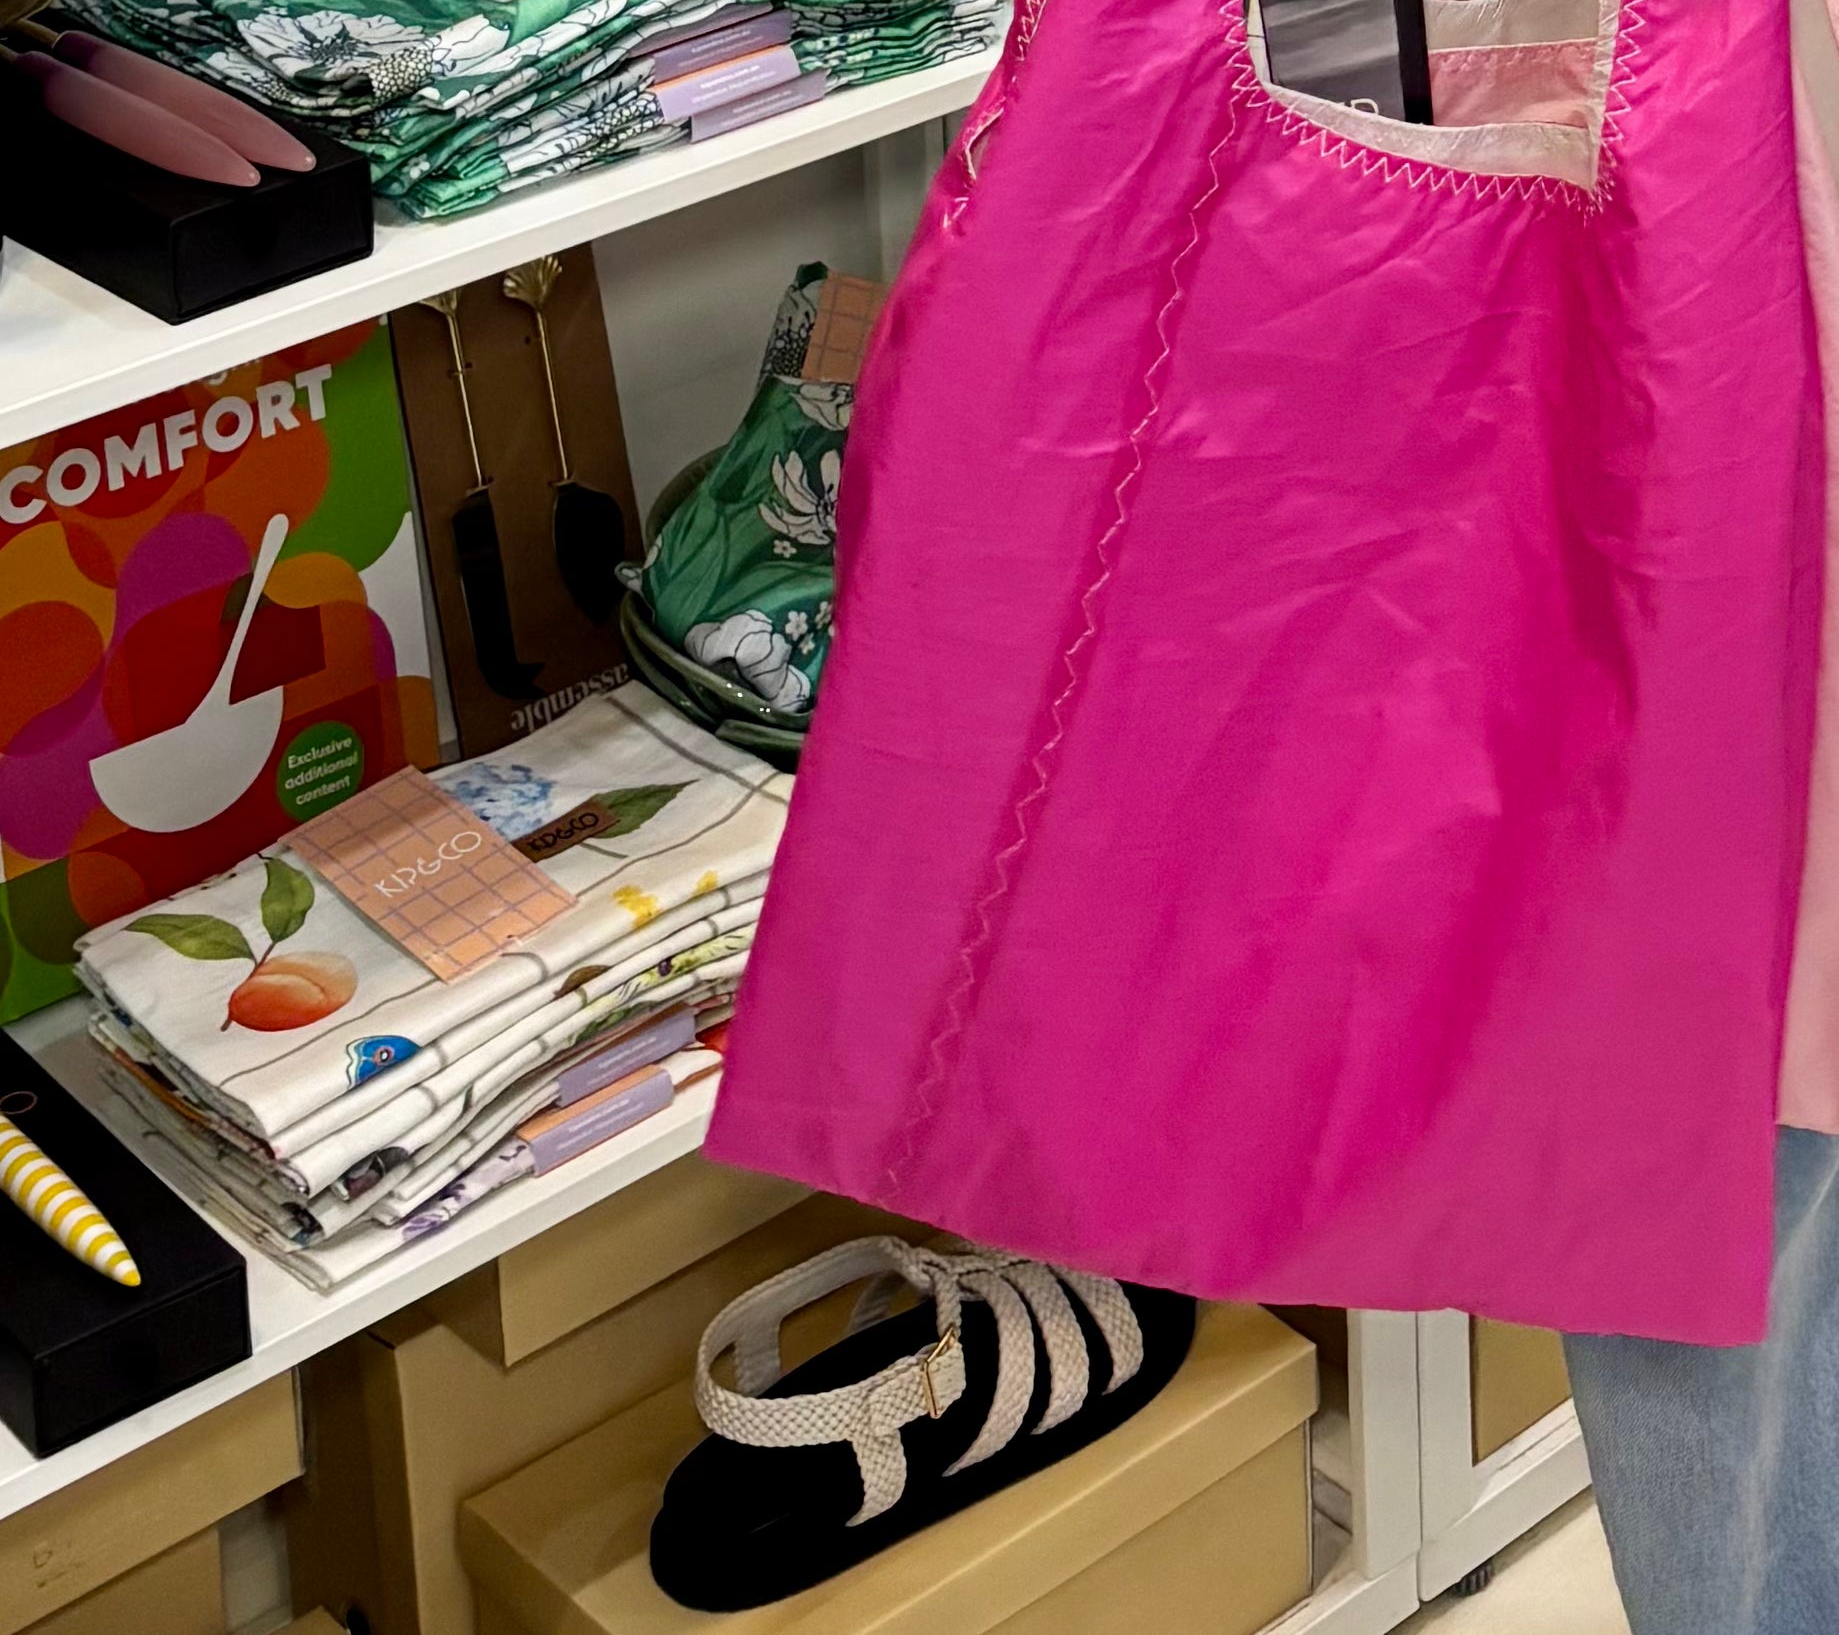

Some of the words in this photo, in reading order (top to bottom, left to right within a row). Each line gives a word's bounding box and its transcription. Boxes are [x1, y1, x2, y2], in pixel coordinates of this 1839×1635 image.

[0, 363, 333, 525] COMFORT
[284, 750, 358, 790] additional
[287, 736, 353, 769] Exclusive
[296, 775, 351, 805] content
